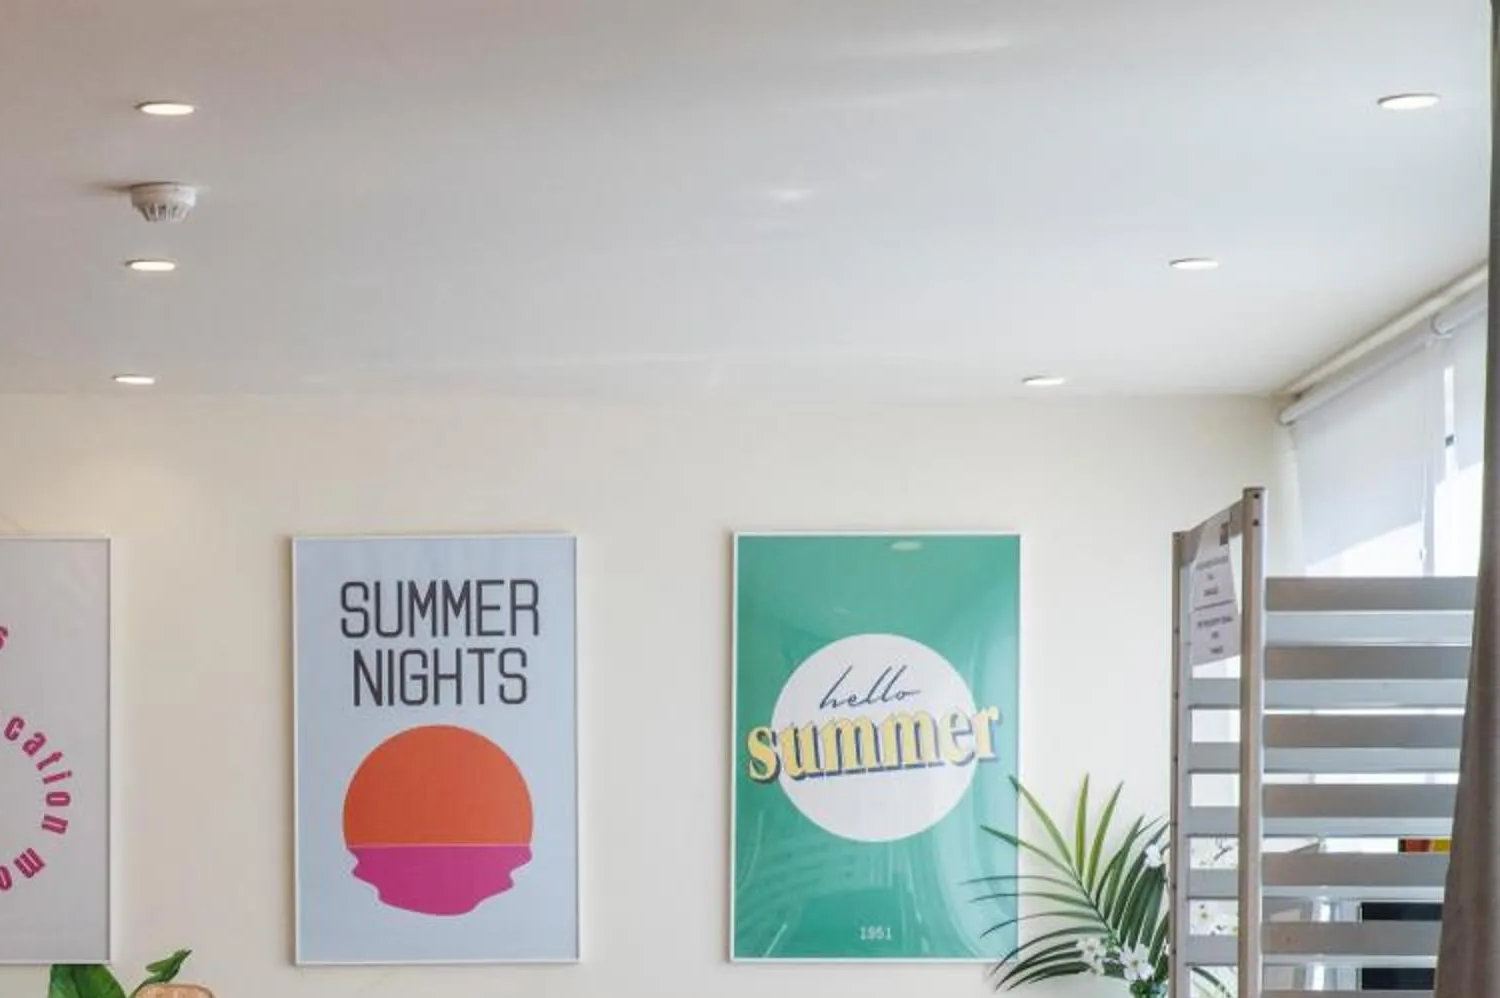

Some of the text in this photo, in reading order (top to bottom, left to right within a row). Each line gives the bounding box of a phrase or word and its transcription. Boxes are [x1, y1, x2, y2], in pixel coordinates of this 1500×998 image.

[340, 579, 540, 638] SUMMER
[353, 647, 528, 707] NIGHTS
[818, 664, 921, 710] hello
[746, 705, 1001, 783] summer
